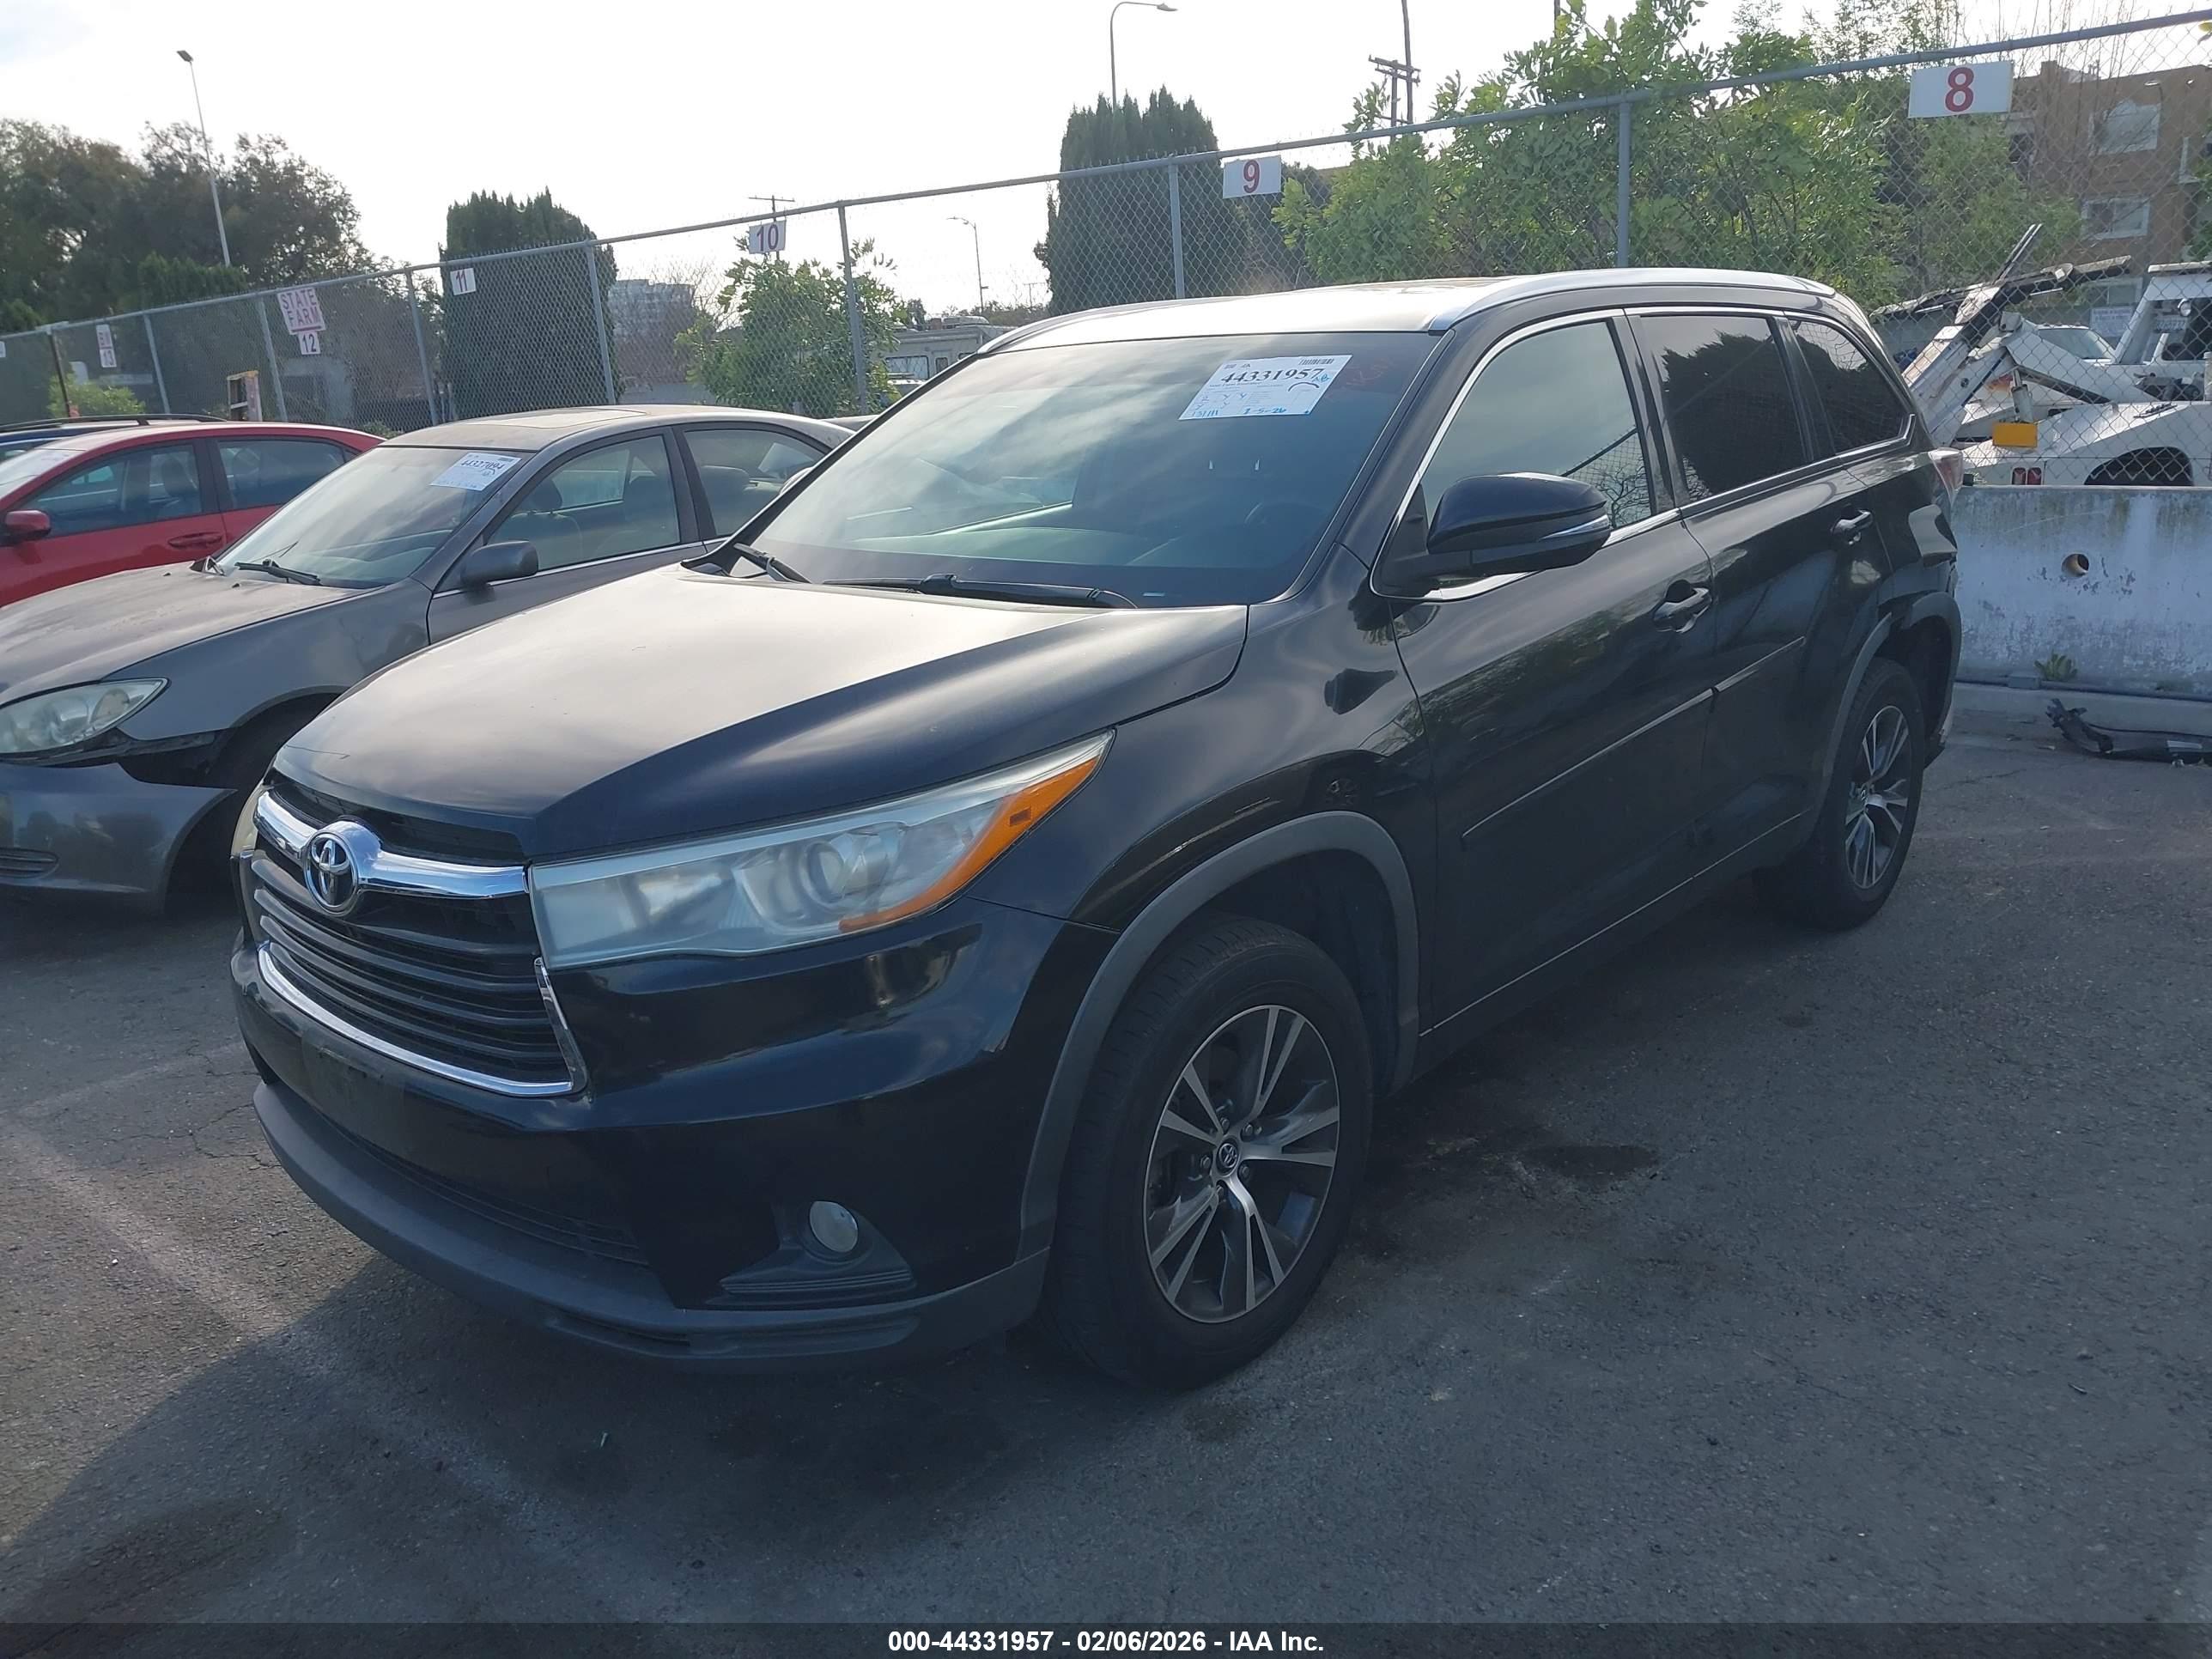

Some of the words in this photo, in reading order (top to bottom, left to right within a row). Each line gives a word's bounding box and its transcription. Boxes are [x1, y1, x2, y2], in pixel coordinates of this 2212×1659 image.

[1945, 67, 1974, 112] 8
[1243, 160, 1261, 193] 9
[757, 223, 779, 251] 10
[456, 269, 468, 293] 11
[280, 289, 317, 310] STATE
[286, 305, 321, 327] FARM
[302, 333, 316, 353] 12
[1220, 368, 1327, 383] 44331957
